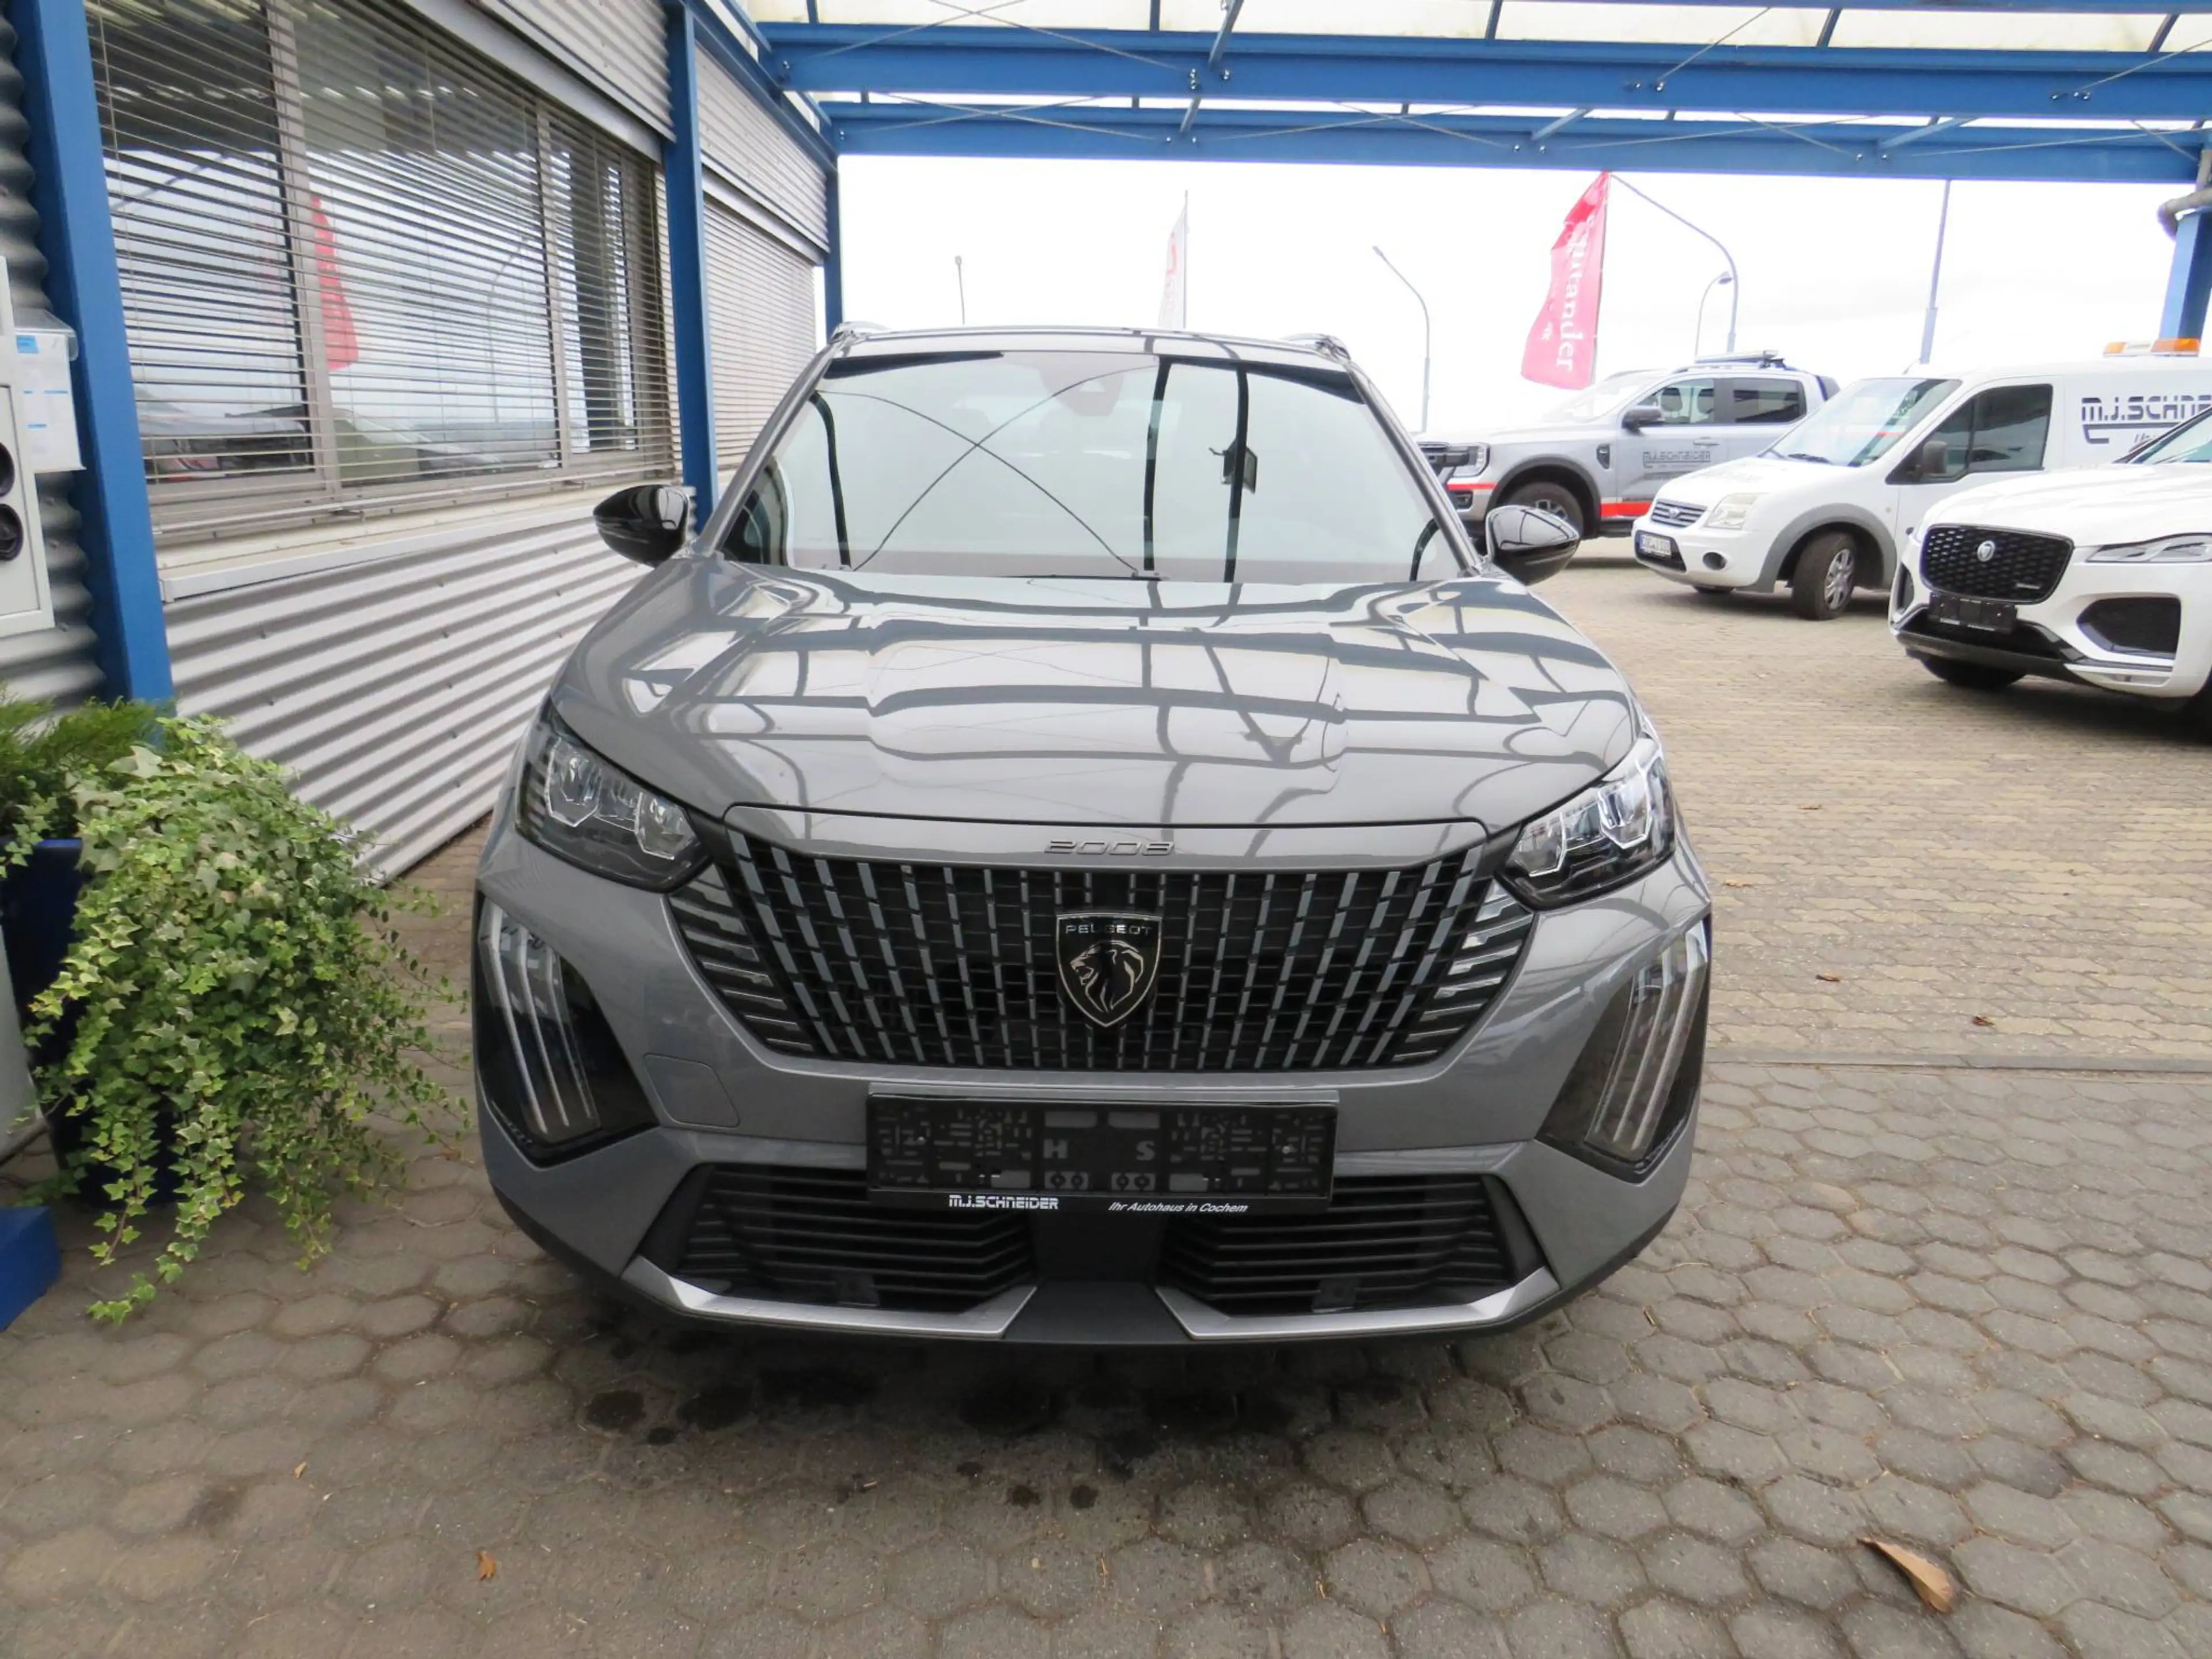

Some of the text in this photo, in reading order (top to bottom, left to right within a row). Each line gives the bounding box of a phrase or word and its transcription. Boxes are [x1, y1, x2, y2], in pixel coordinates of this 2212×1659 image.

[1044, 839, 1174, 855] 2008
[1108, 1202, 1248, 1213] Ihr Autohaus in Cochem
